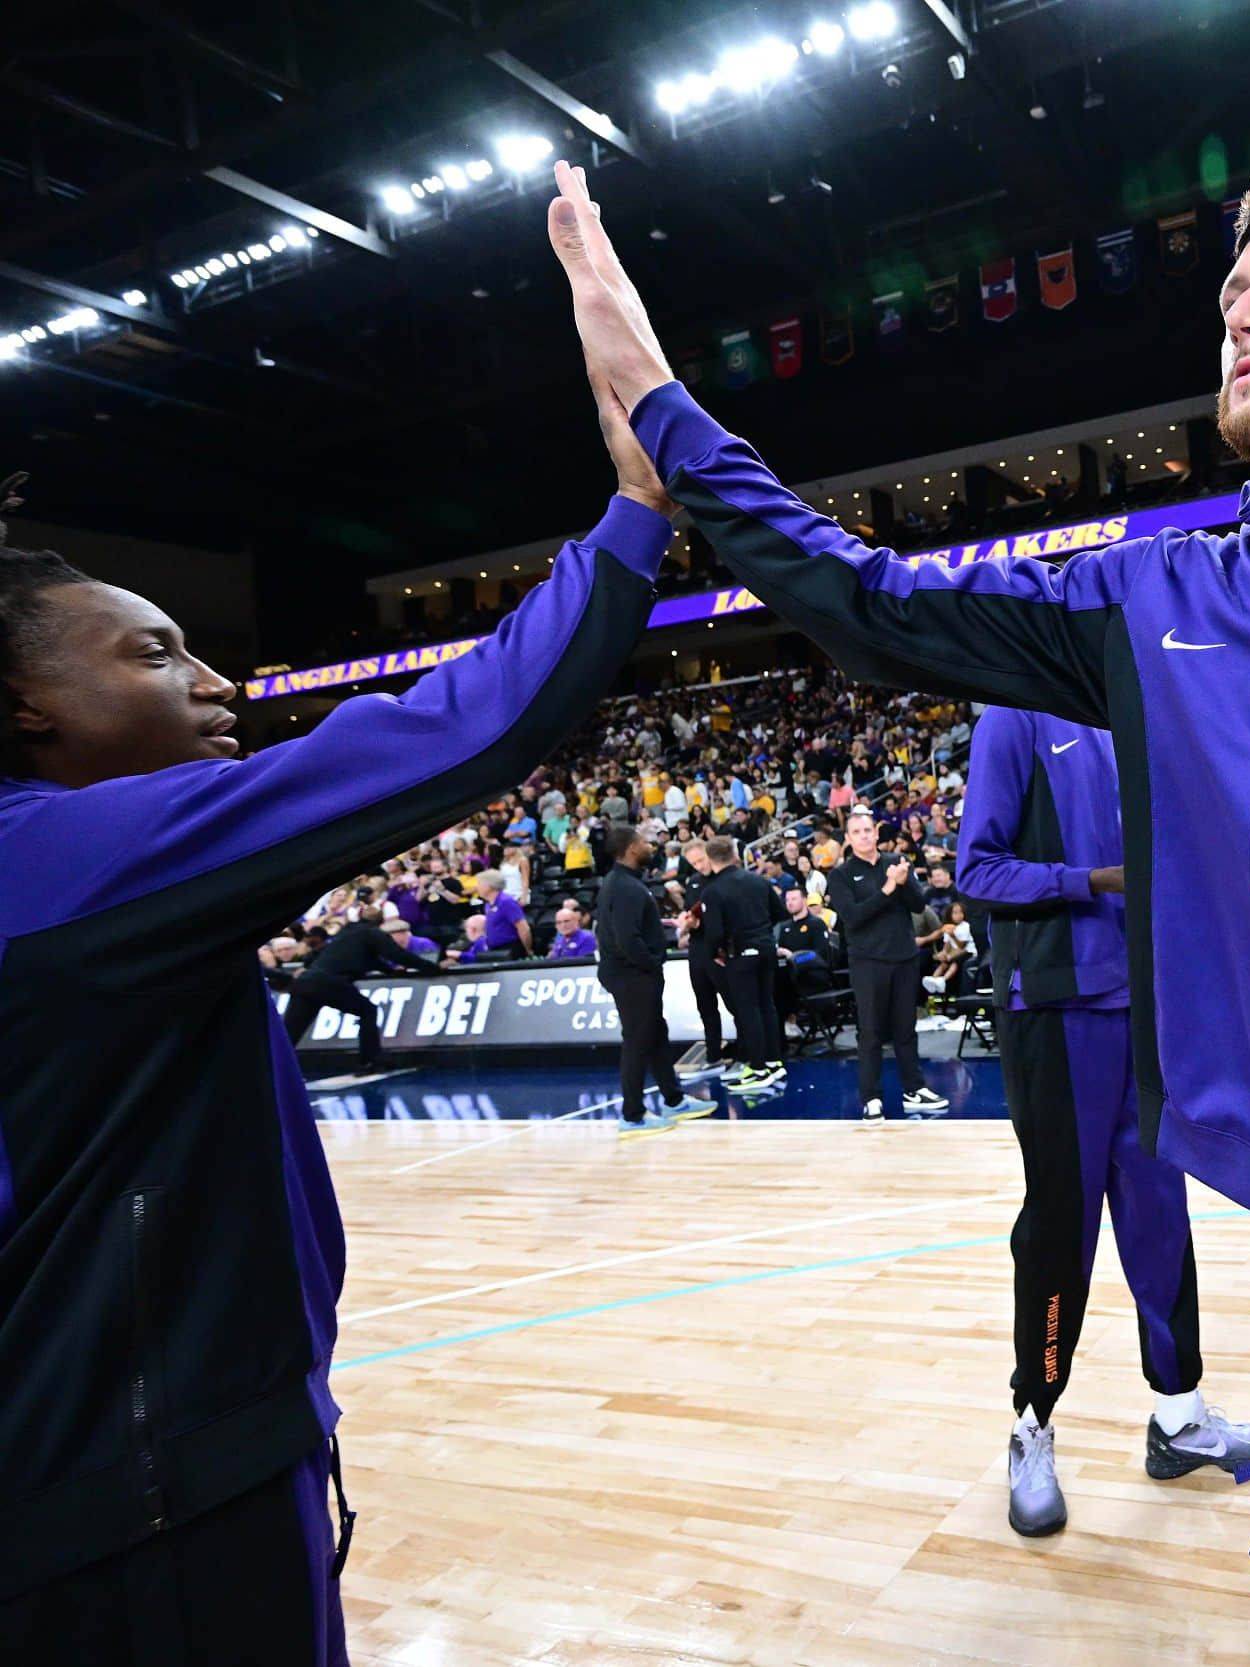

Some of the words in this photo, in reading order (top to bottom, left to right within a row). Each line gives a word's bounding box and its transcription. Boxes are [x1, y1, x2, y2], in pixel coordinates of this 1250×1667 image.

[712, 587, 767, 615] LO
[269, 657, 380, 696] ANGELES
[415, 982, 500, 1037] BET
[1044, 1345, 1058, 1383] SUNS
